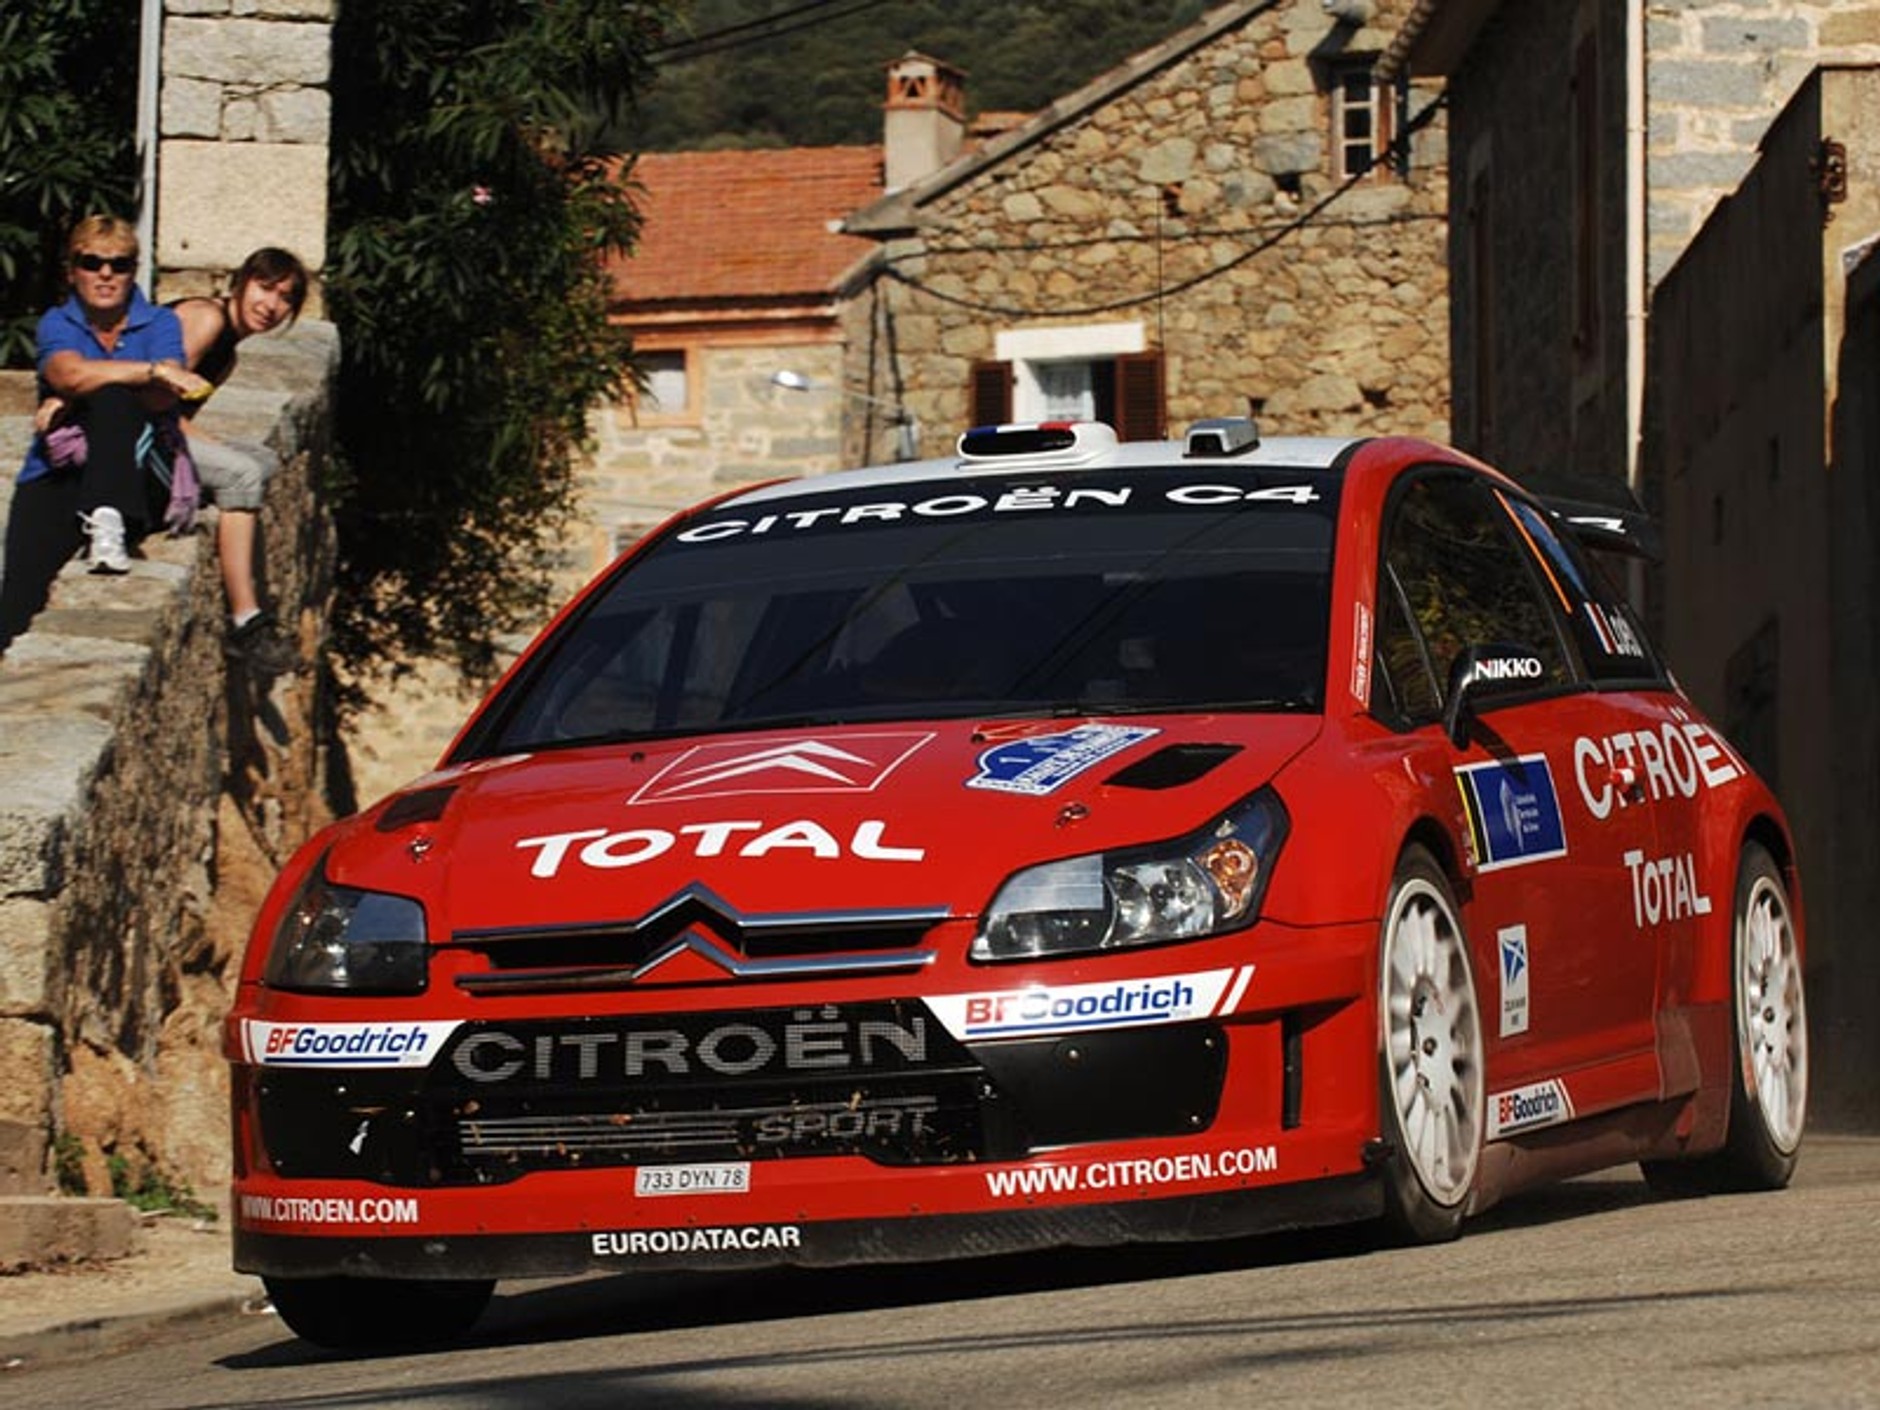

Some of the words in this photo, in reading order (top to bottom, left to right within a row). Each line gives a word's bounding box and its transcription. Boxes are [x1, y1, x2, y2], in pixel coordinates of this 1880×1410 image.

[676, 480, 1132, 543] CITROËN
[1165, 485, 1320, 505] C4
[1475, 658, 1542, 680] NIKKO
[516, 820, 925, 878] TOTAL
[1623, 849, 1713, 928] TOTAL
[265, 1025, 428, 1056] BFGoodrich
[453, 1003, 927, 1083] CITROËN
[757, 1105, 938, 1142] SPORT
[642, 1170, 673, 1191] 733
[679, 1168, 717, 1189] DYN
[722, 1167, 744, 1186] 78
[986, 1146, 1279, 1197] WWW.CITROEN.COM
[591, 1225, 801, 1256] EURODATACAR
